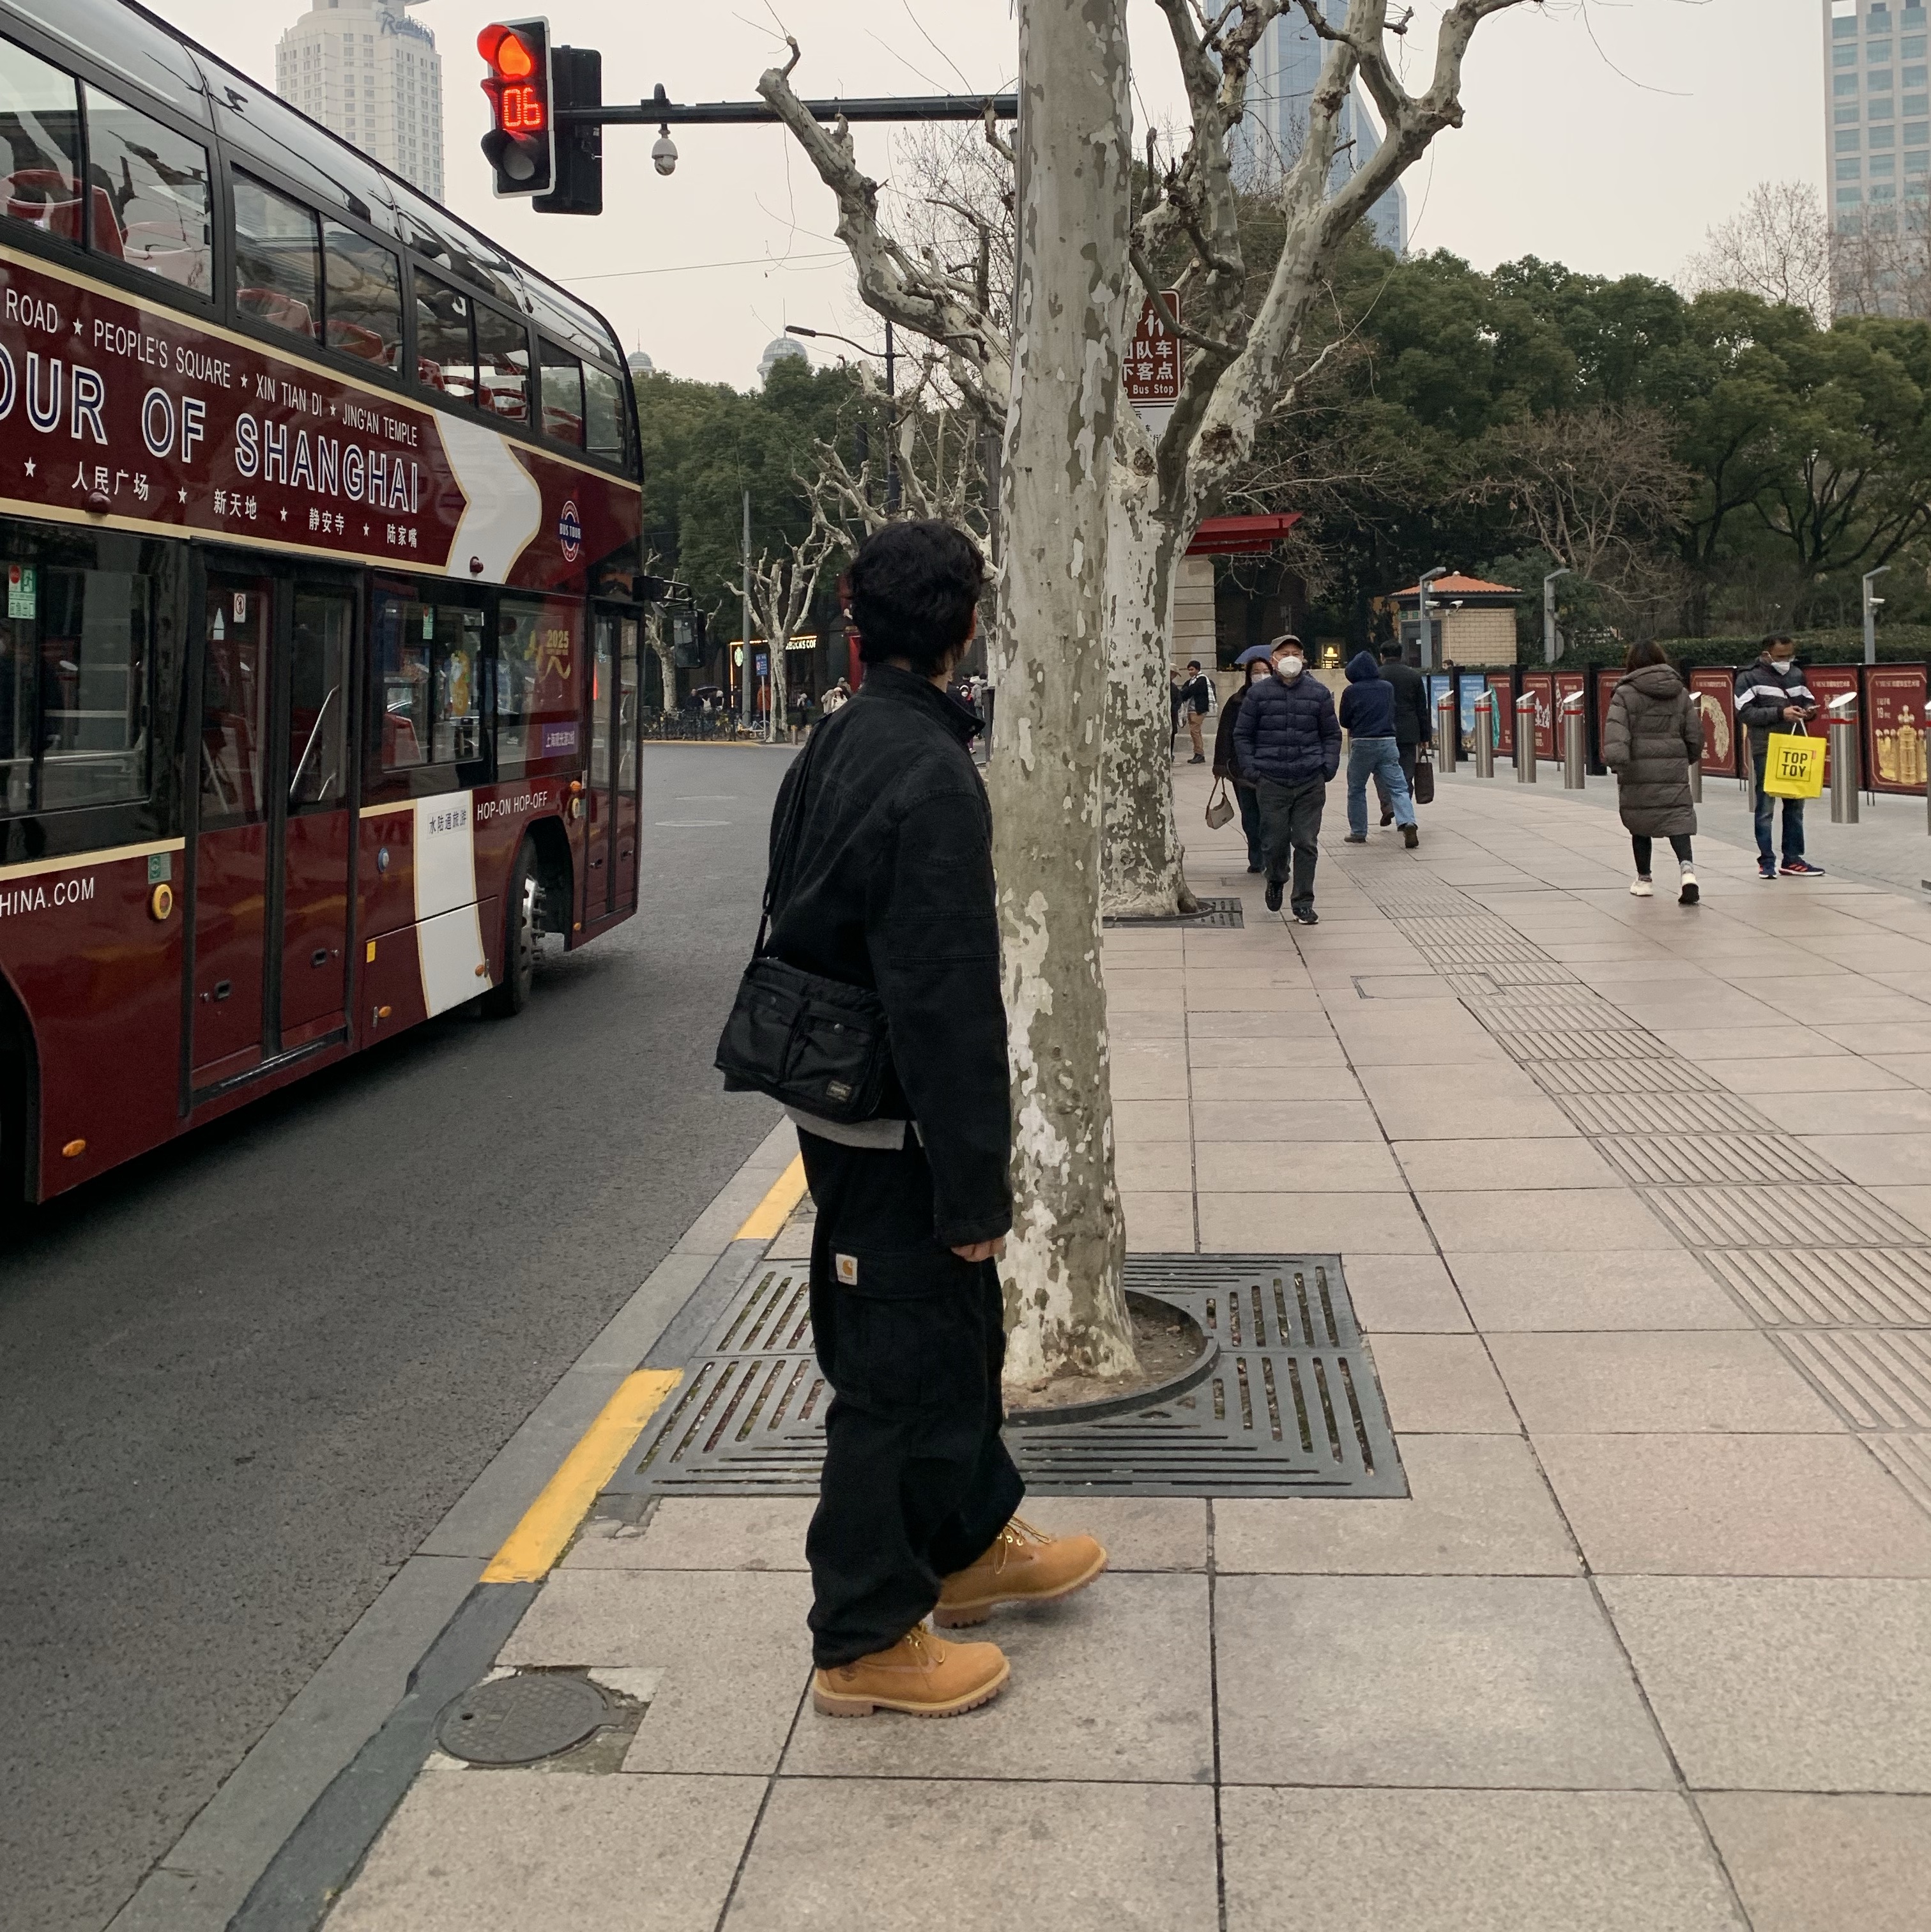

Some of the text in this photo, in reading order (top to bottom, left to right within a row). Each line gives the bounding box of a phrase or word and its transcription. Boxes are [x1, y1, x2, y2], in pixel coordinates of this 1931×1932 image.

[503, 87, 541, 127] 06
[6, 288, 418, 447] ROAD PEOPLE'S SQUARE XIN TIAN DI JING'AN TEMPLE
[1133, 384, 1150, 395] Bus
[1154, 383, 1174, 395] Stop
[141, 387, 206, 464] OF
[234, 412, 418, 514] SHANGHAI
[71, 461, 418, 548] 人民广场 新天地 静安寺 陆家嘴
[546, 629, 569, 648] 2025
[1782, 763, 1806, 778] TOY
[1783, 751, 1808, 764] TOP
[477, 791, 548, 821] HOP-ON HOP-OFF
